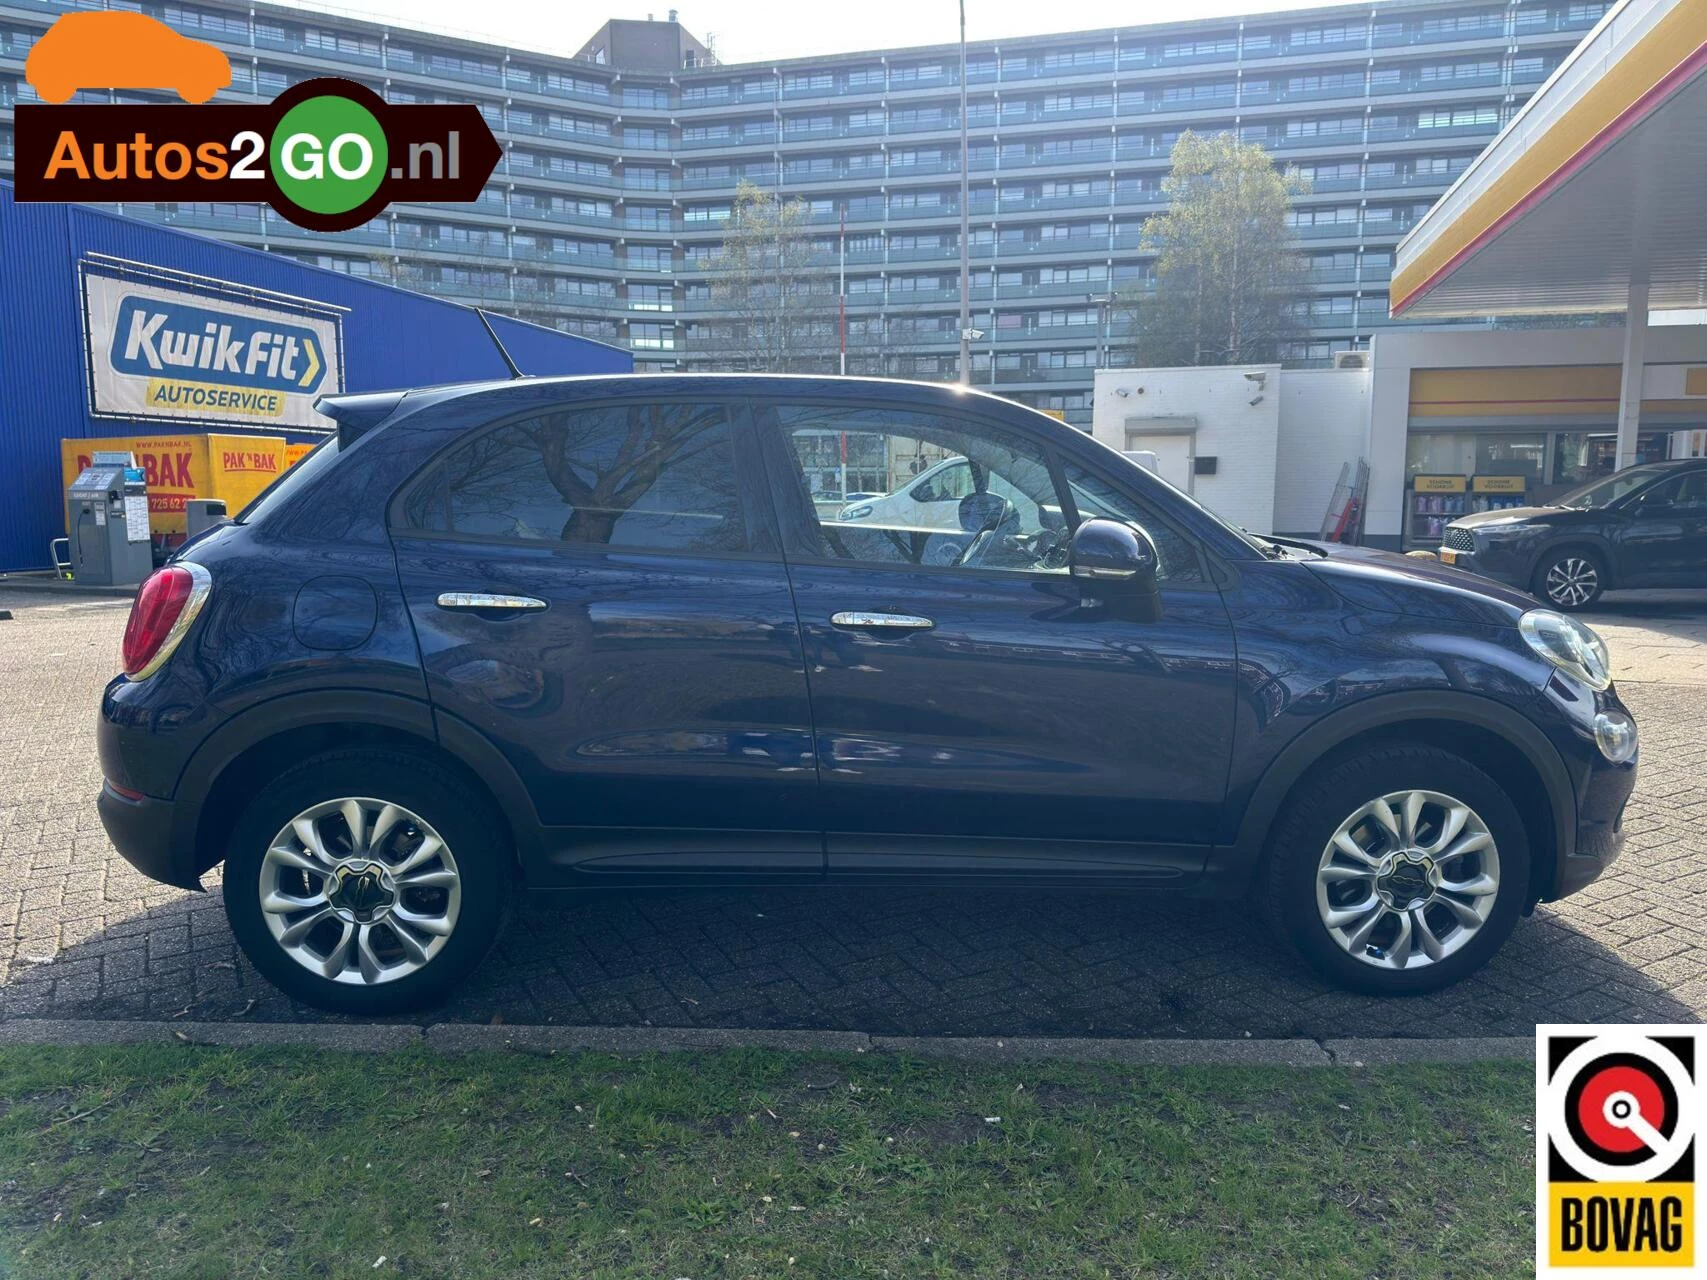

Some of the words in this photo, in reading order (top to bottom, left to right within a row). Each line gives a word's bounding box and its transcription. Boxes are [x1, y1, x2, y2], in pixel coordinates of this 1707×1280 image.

[154, 384, 278, 412] AUTOSERVICE
[223, 451, 246, 469] PAK
[253, 453, 277, 470] BAK
[151, 498, 168, 510] 725
[169, 498, 181, 509] 62
